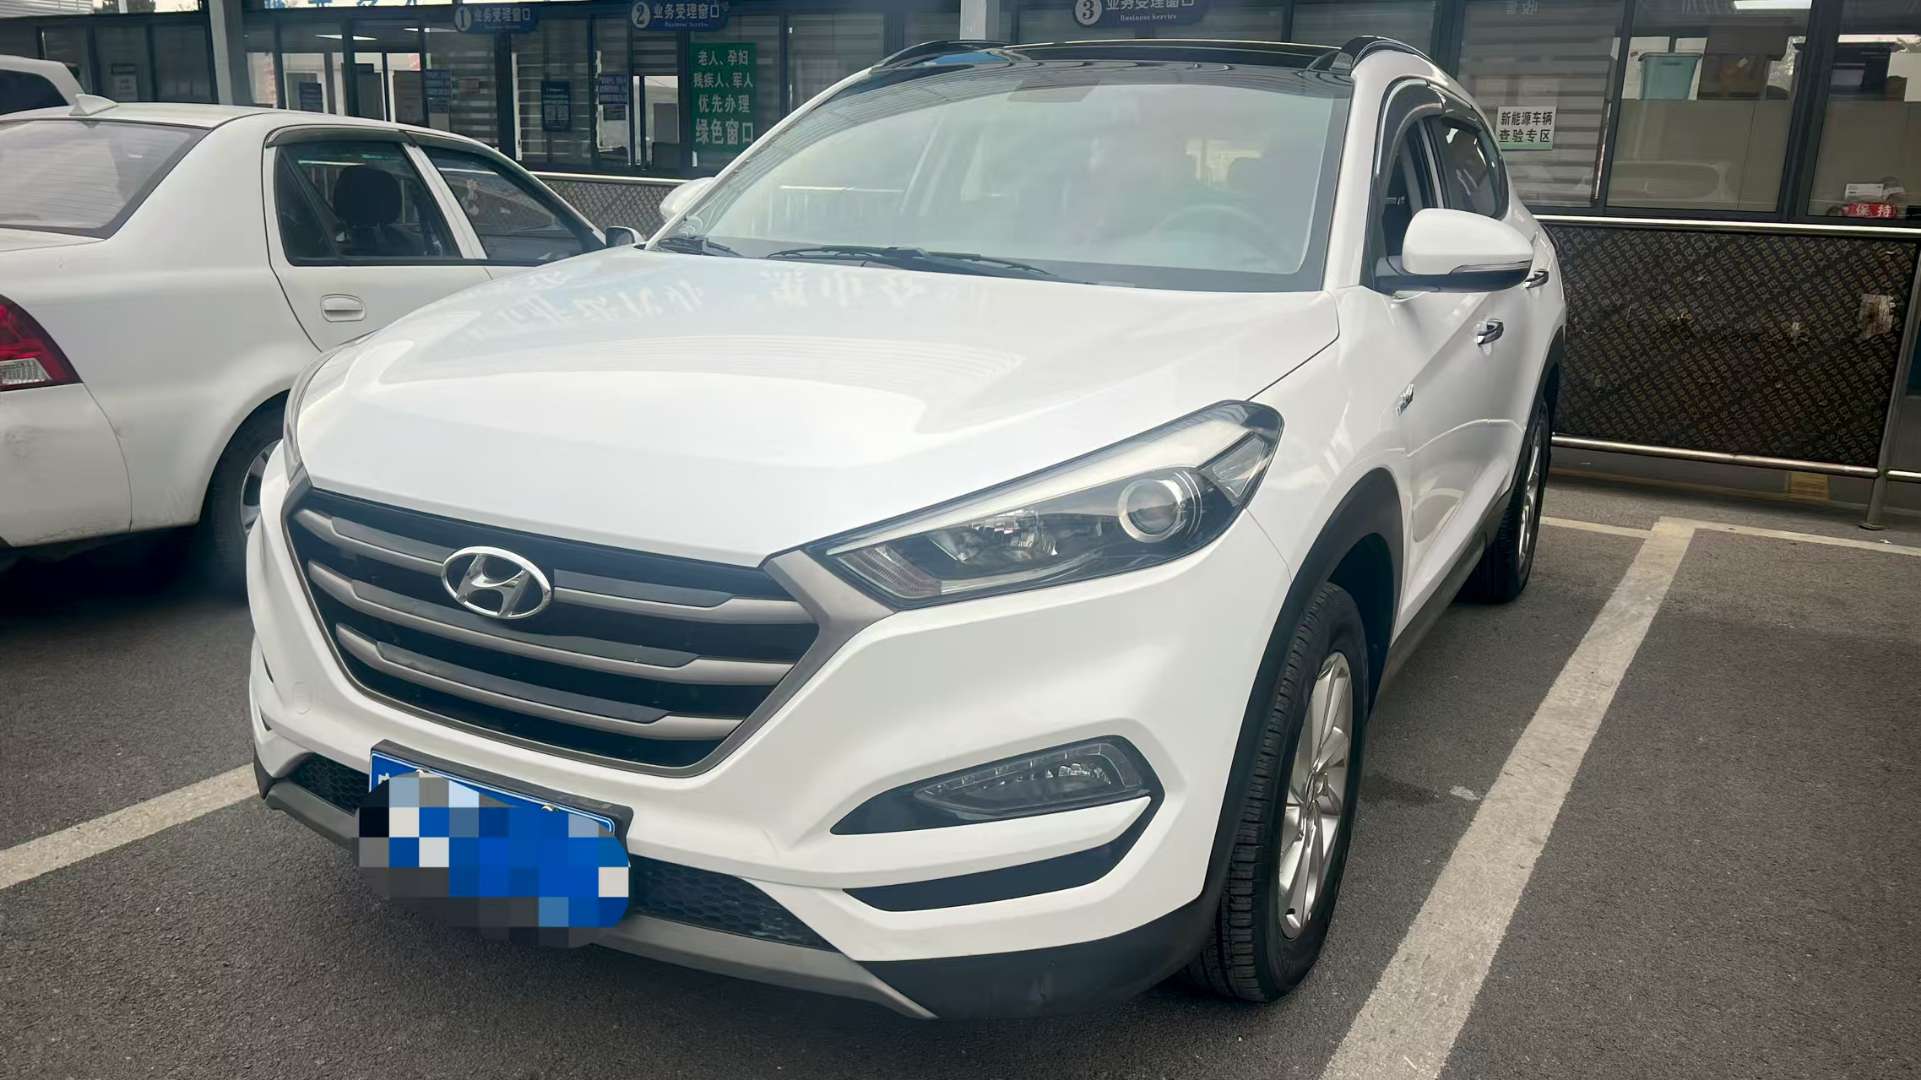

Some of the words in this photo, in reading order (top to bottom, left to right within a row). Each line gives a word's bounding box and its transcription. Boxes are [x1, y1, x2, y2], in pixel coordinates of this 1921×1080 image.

[474, 7, 531, 22] 业务受理窗口
[654, 2, 720, 19] 业务受理窗口
[698, 49, 748, 66] 老人、孕妇
[693, 72, 753, 88] 残疾人、军人
[699, 94, 750, 113] 优先办理
[1501, 111, 1552, 126] 新能源车辆
[695, 118, 754, 145] 绿色窗口
[1499, 129, 1551, 142] 查验专区
